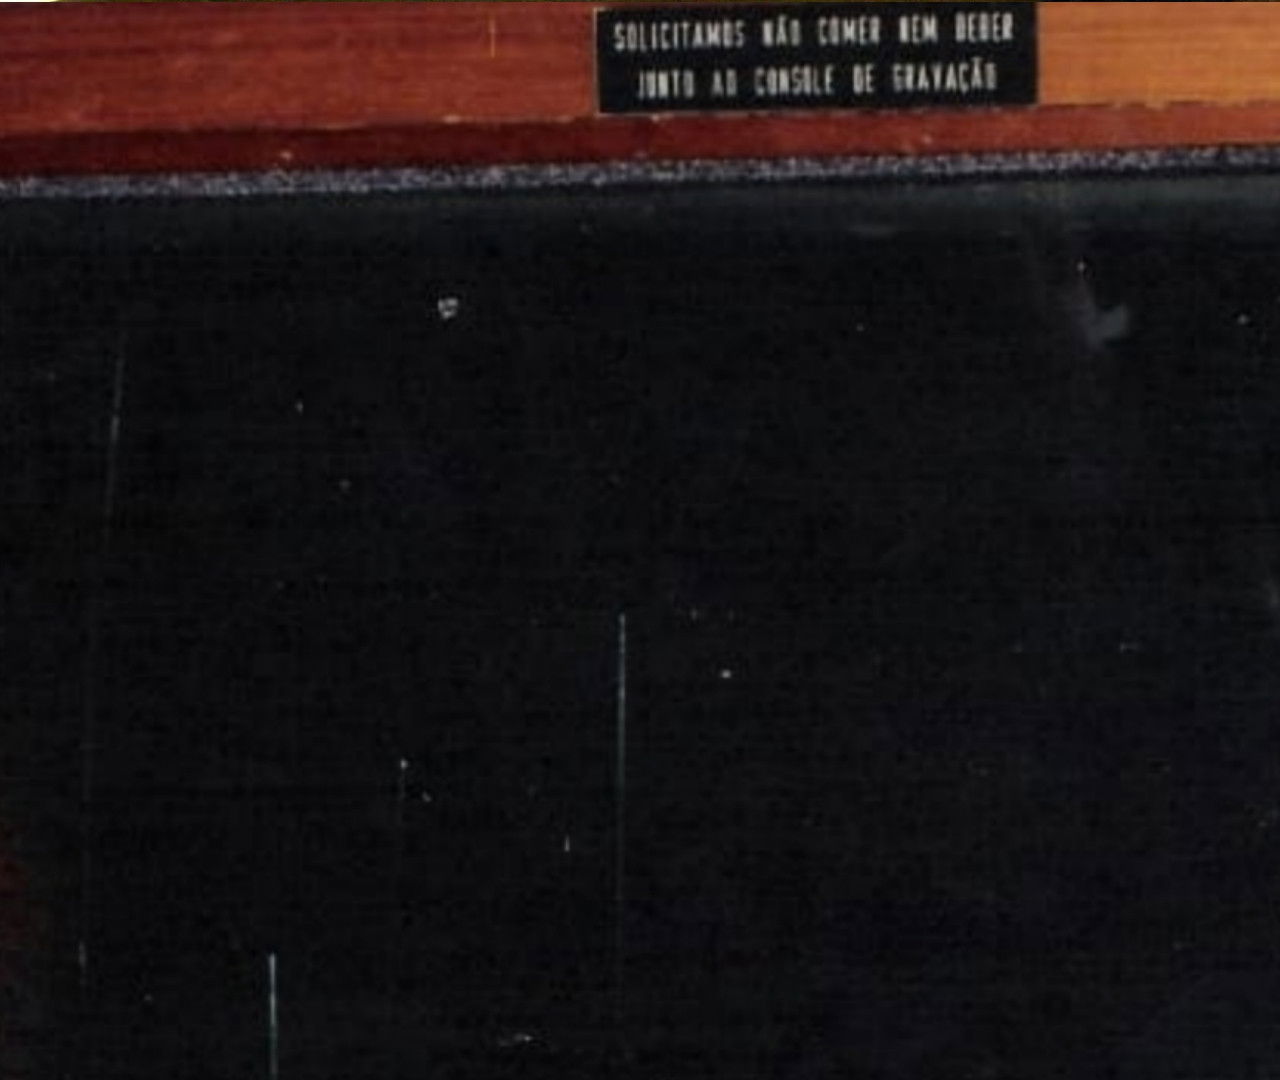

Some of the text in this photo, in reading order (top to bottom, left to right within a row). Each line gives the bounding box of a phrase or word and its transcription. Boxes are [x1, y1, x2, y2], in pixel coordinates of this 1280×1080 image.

[613, 11, 1014, 51] SOLICITAMOS NÃO COMER NEM BEBER
[638, 56, 998, 99] JUNTO AO CONSOLE DE GRAVAÇÃO
